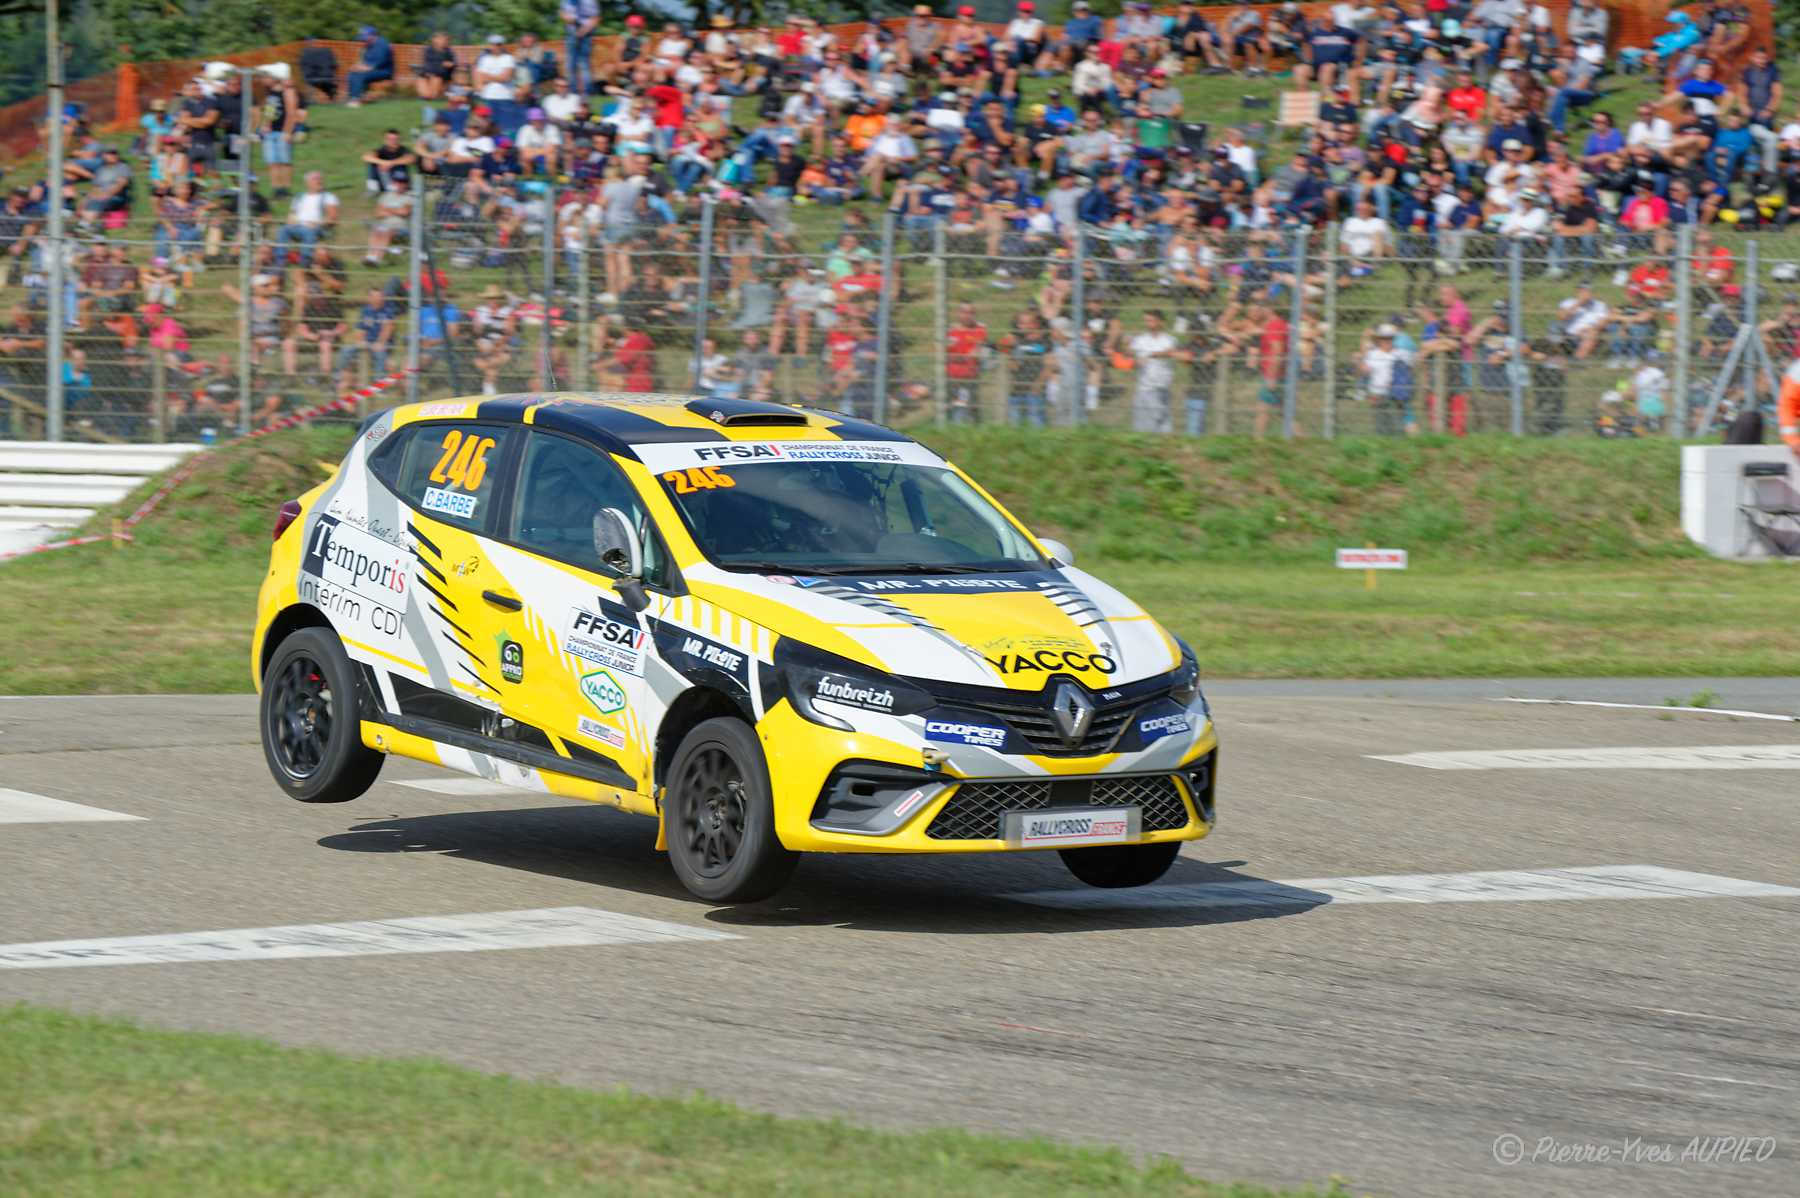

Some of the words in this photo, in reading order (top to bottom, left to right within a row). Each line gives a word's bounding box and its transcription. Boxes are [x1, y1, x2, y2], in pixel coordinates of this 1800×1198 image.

[430, 429, 496, 491] 246
[694, 444, 773, 461] FFSA
[790, 450, 864, 460] RALLYCROSS
[865, 451, 902, 462] JUNIOR
[662, 465, 737, 494] 246
[312, 519, 406, 594] Temporis
[298, 573, 362, 621] Intérim
[371, 606, 404, 640] CDI
[573, 612, 635, 649] FFSA
[984, 650, 1117, 674] YACCO
[585, 680, 624, 706] YACCO
[817, 676, 895, 707] funbreizh
[926, 721, 1007, 740] COOPER
[1140, 713, 1185, 732] COOPER
[963, 735, 1004, 747] TIRES
